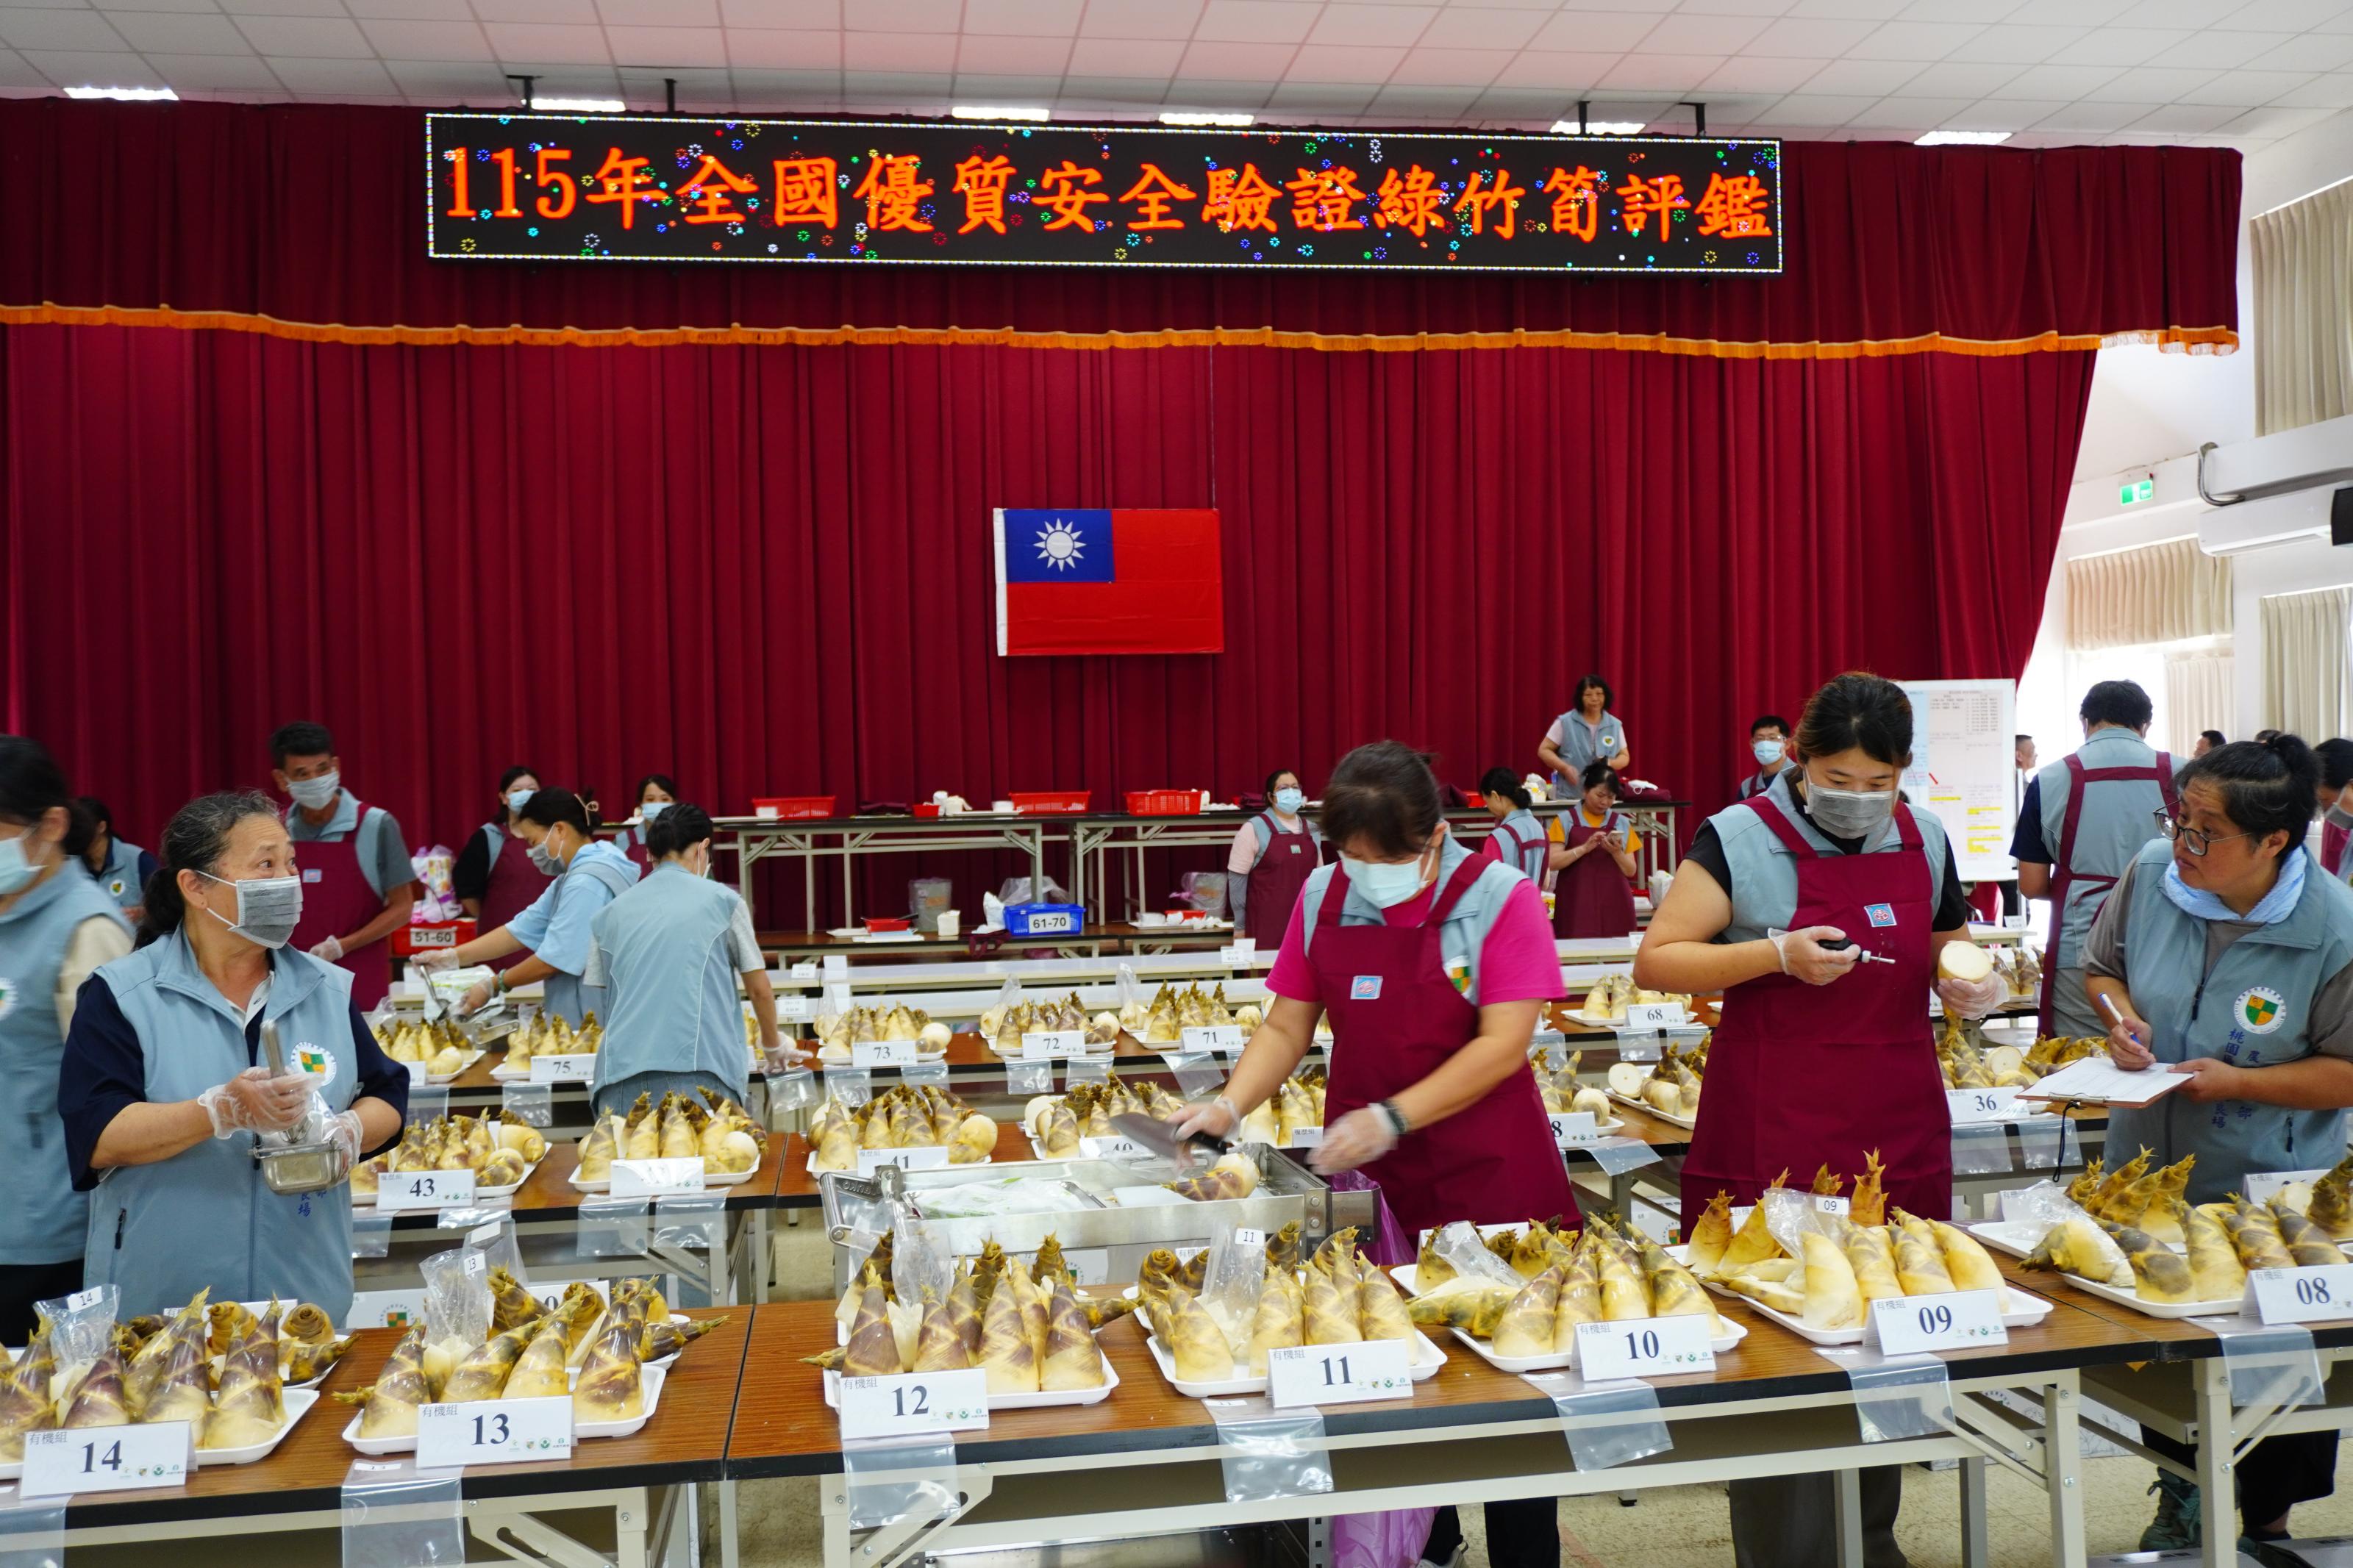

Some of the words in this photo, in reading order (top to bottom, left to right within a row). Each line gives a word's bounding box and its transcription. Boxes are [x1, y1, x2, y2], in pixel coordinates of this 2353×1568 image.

[446, 146, 1774, 242] 115年全國優質安全驗證綠竹筍評鑑
[1032, 917, 1066, 928] 61-70
[414, 931, 451, 942] 51-60
[1647, 1008, 1663, 1021] 68
[1043, 1037, 1060, 1050] 72
[1202, 1031, 1218, 1044] 71
[874, 1046, 890, 1059] 73
[553, 1061, 571, 1074] 75
[1974, 1094, 1997, 1111] 36
[1552, 1120, 1563, 1138] 8
[410, 1178, 435, 1198] 43
[1824, 1200, 1837, 1211] 09
[1243, 1231, 1254, 1242] 11
[2296, 1277, 2330, 1305] 08
[79, 1292, 93, 1306] 14
[1918, 1305, 1952, 1334] 09
[1580, 1322, 1612, 1335] 有機組
[1624, 1330, 1660, 1360] 10
[1273, 1349, 1306, 1361] 有機組
[1319, 1356, 1353, 1386] 11
[843, 1376, 879, 1390] 有機組
[890, 1385, 929, 1417] 12
[422, 1404, 458, 1417] 有機組
[471, 1413, 510, 1445] 13
[29, 1431, 68, 1445] 有機組
[79, 1439, 122, 1473] 14
